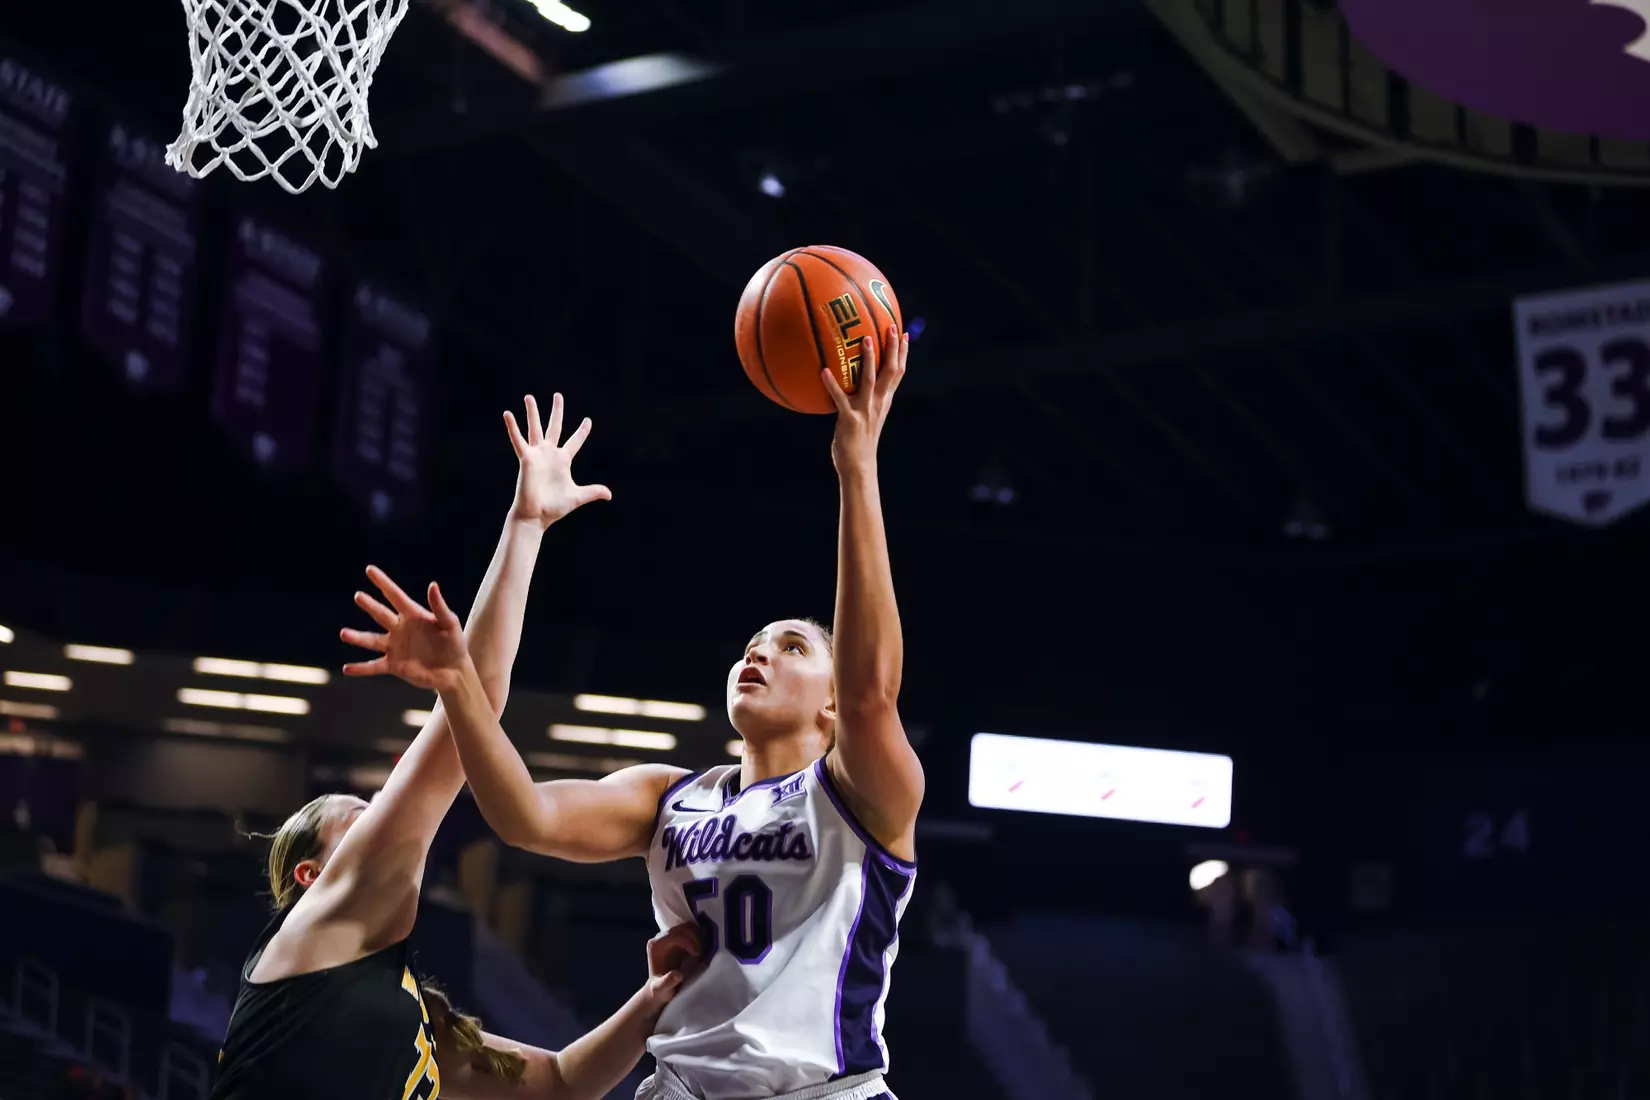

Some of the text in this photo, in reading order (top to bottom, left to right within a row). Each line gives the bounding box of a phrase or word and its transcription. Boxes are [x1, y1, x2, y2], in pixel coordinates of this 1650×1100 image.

[1534, 337, 1650, 450] 33
[661, 813, 812, 871] Wildcats
[1461, 808, 1533, 861] 24
[682, 874, 773, 965] 50
